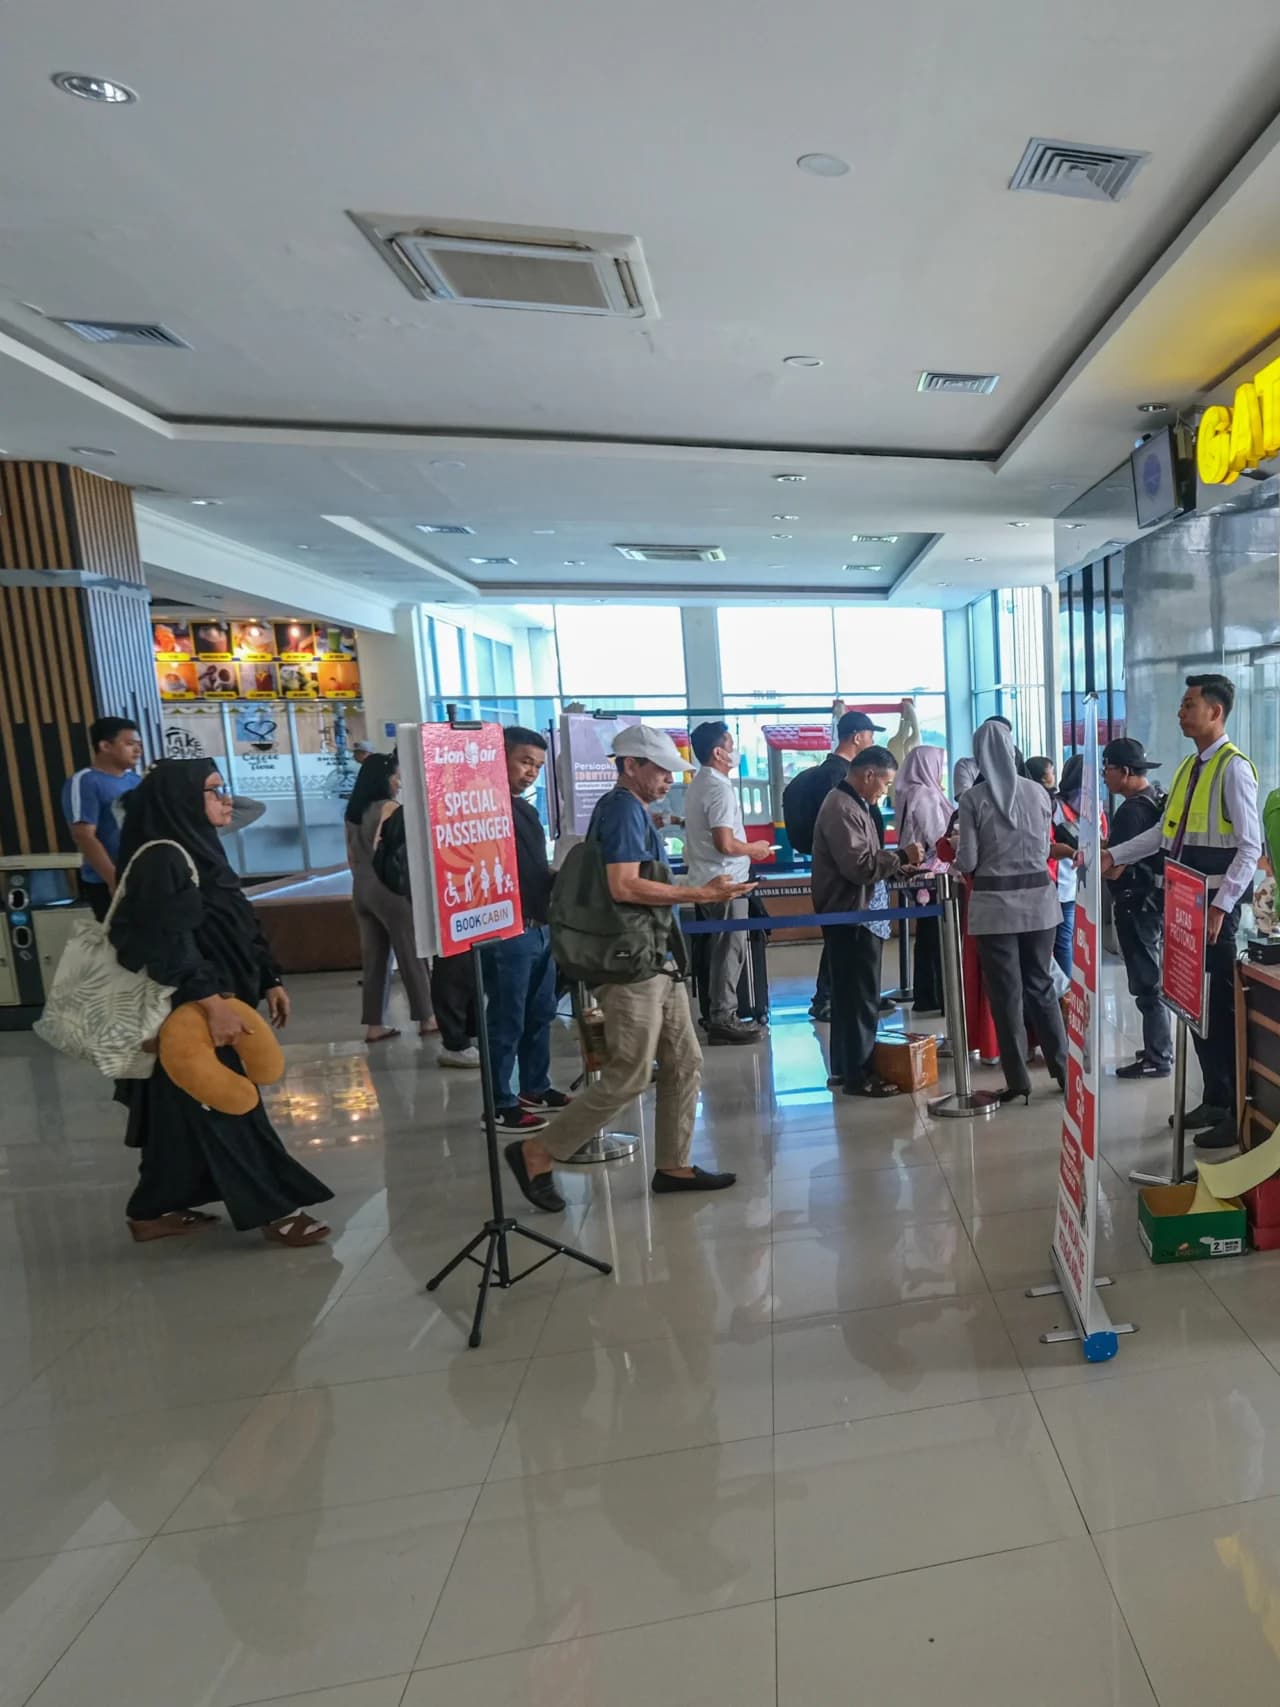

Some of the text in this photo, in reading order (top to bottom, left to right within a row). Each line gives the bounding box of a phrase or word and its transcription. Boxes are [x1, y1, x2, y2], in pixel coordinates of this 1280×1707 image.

[434, 746, 497, 763] Lion air
[574, 762, 617, 772] Persiapka
[575, 770, 619, 781] IDENTITA
[444, 788, 498, 816] SPECIAL
[436, 816, 511, 849] PASSENGER
[754, 888, 780, 896] BANDAR
[456, 907, 509, 933] BOOKCABIN
[1175, 907, 1193, 930] BATAS
[1213, 1242, 1220, 1250] 2
